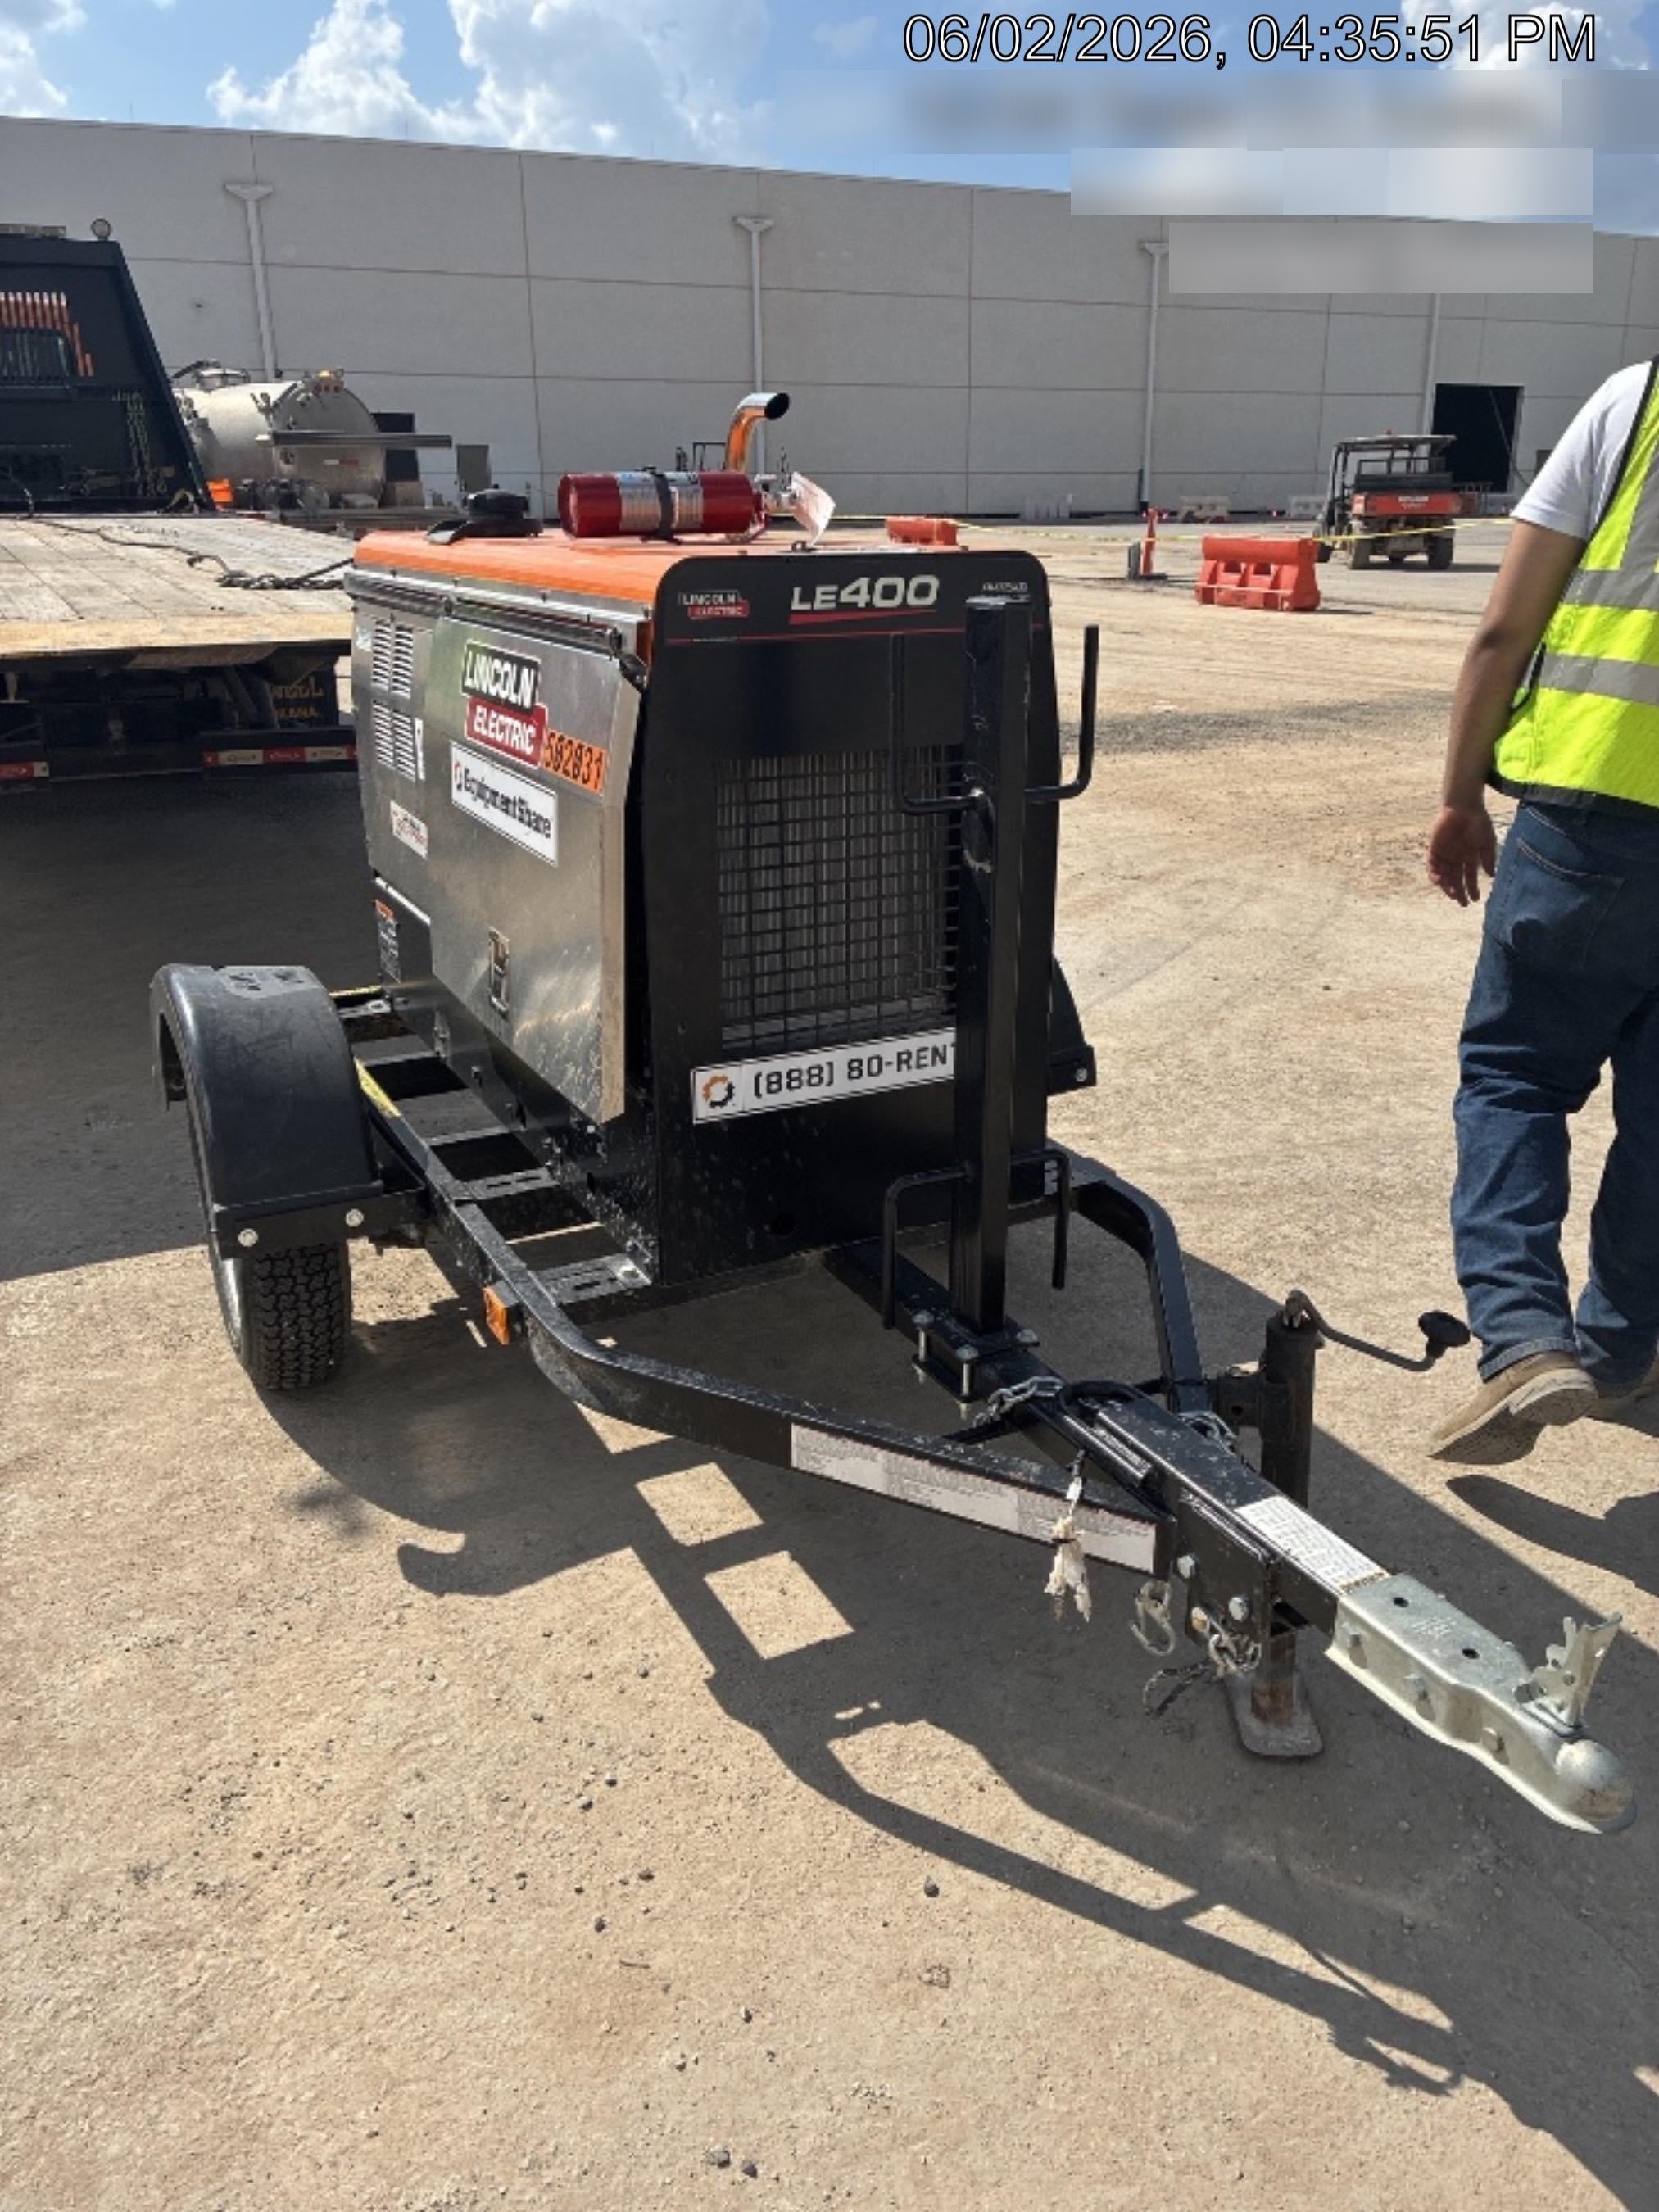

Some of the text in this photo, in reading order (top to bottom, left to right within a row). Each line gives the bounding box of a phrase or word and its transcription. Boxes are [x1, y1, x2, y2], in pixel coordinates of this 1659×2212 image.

[682, 593, 736, 605] LINCOLN
[791, 574, 940, 610] LE400
[464, 650, 535, 709] LINCOLN
[474, 705, 537, 755] ELECTRIC
[464, 767, 551, 840] EquipmentShare
